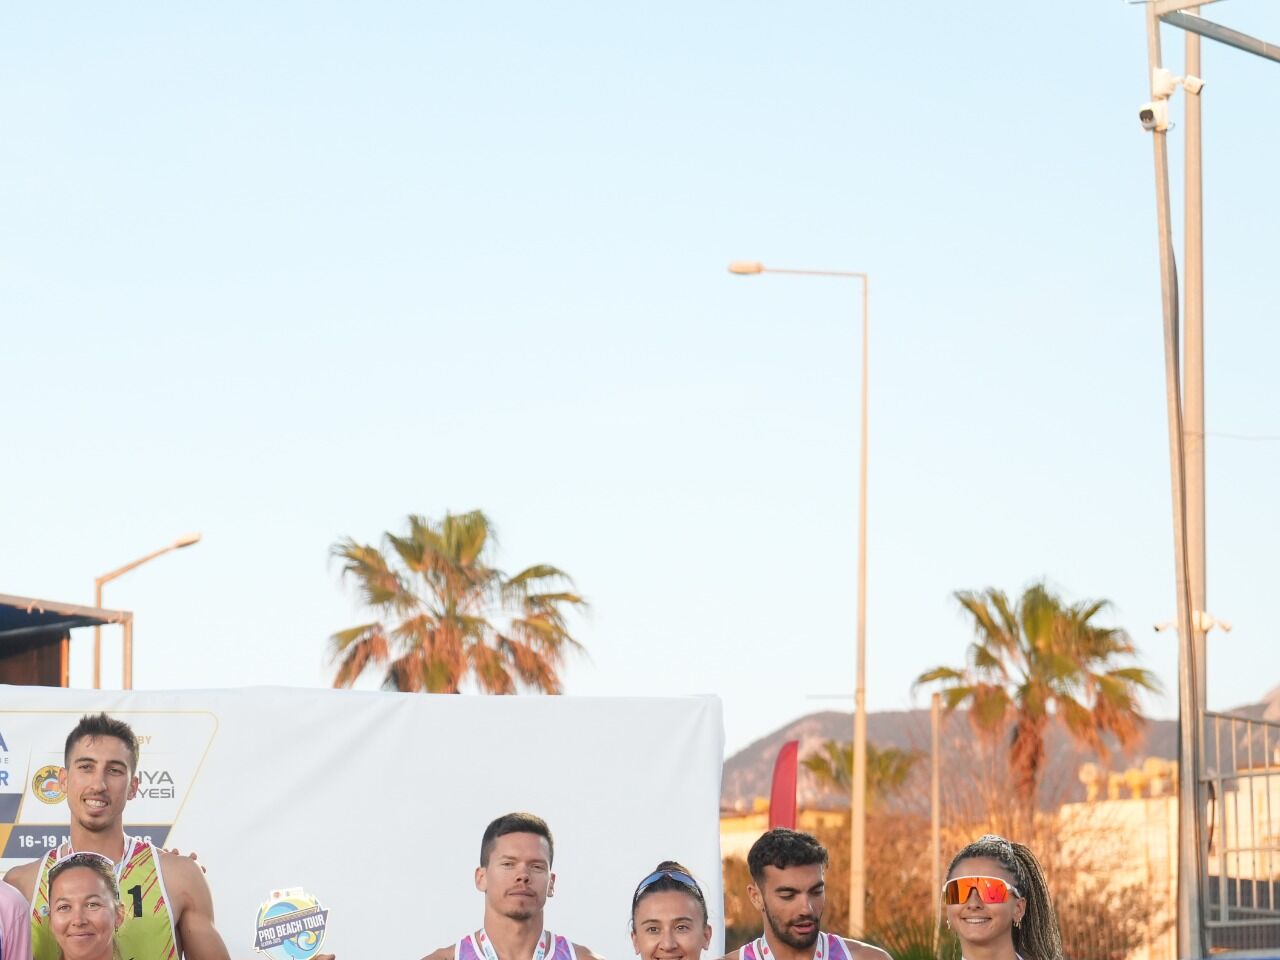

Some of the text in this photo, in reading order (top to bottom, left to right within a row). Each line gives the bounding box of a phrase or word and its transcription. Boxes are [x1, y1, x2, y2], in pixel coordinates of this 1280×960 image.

[19, 835, 57, 848] 16-19
[128, 884, 143, 918] 1
[258, 914, 325, 942] PRO BEACH TOUR
